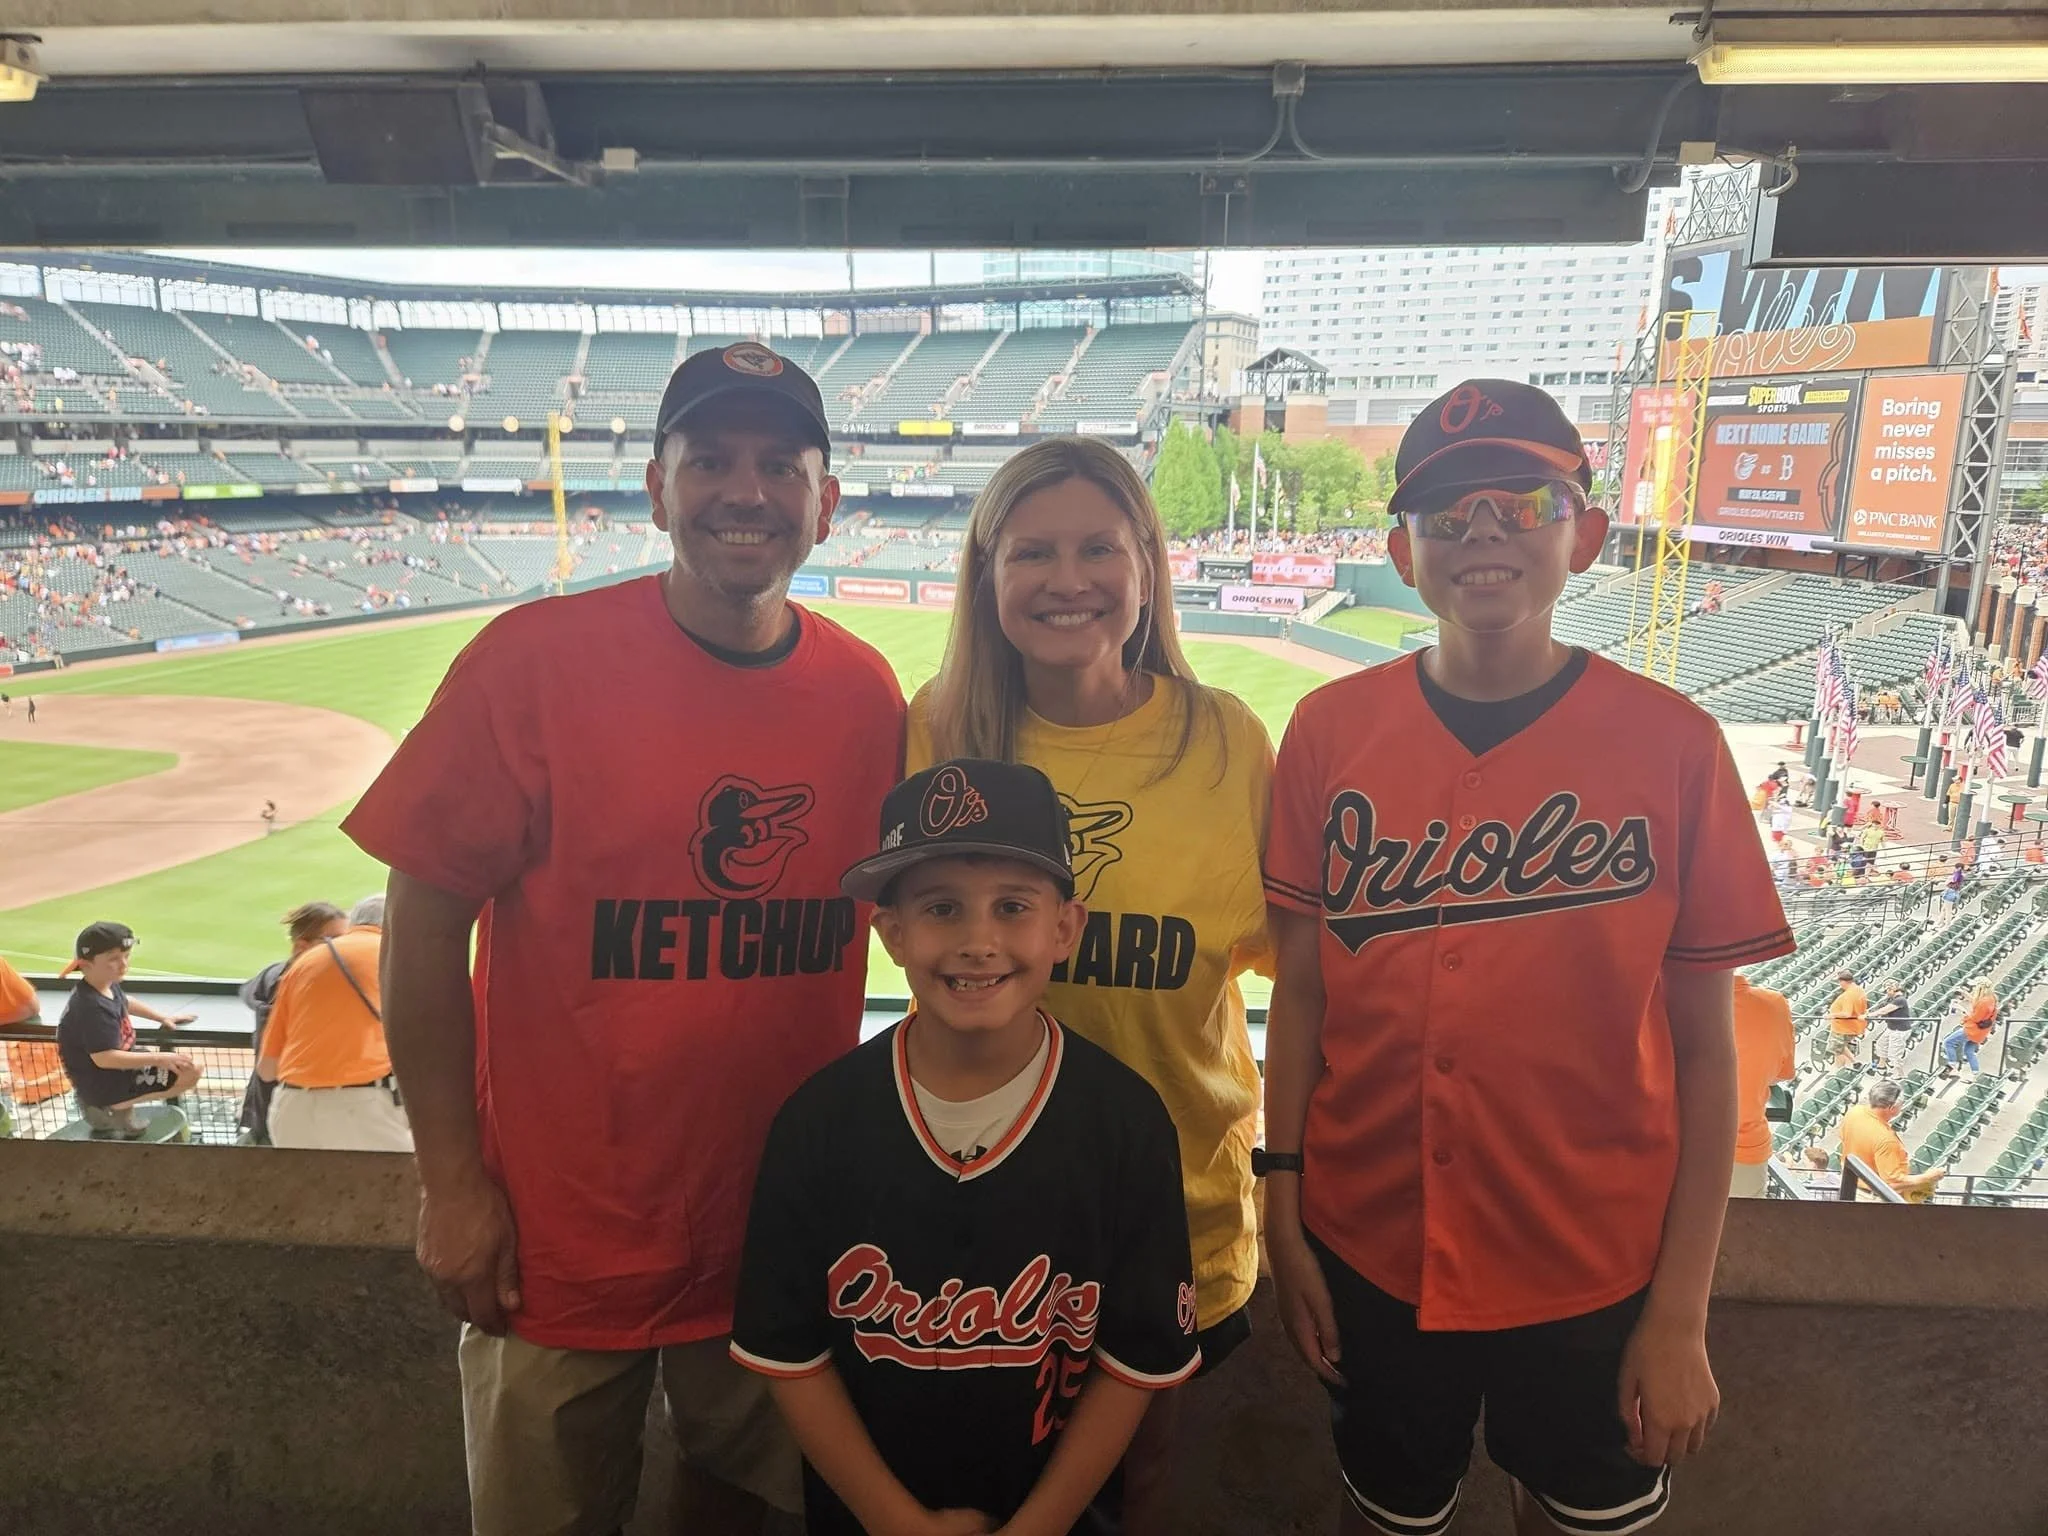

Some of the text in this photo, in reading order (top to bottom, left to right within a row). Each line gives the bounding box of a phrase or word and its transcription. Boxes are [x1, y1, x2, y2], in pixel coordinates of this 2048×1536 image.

[1757, 404, 1788, 413] SPORTS
[1882, 397, 1942, 419] Boring
[1716, 423, 1831, 445] NEXT HOME GAME
[1882, 423, 1935, 437] never
[1874, 441, 1936, 459] misses
[1870, 464, 1937, 484] a pitch.
[1718, 530, 1790, 546] ORIOLES WIN
[1232, 595, 1295, 605] ORIOLES WIN
[1322, 789, 1657, 914] Orioles
[592, 897, 856, 980] KETCHUP
[1050, 911, 1196, 991] ARD
